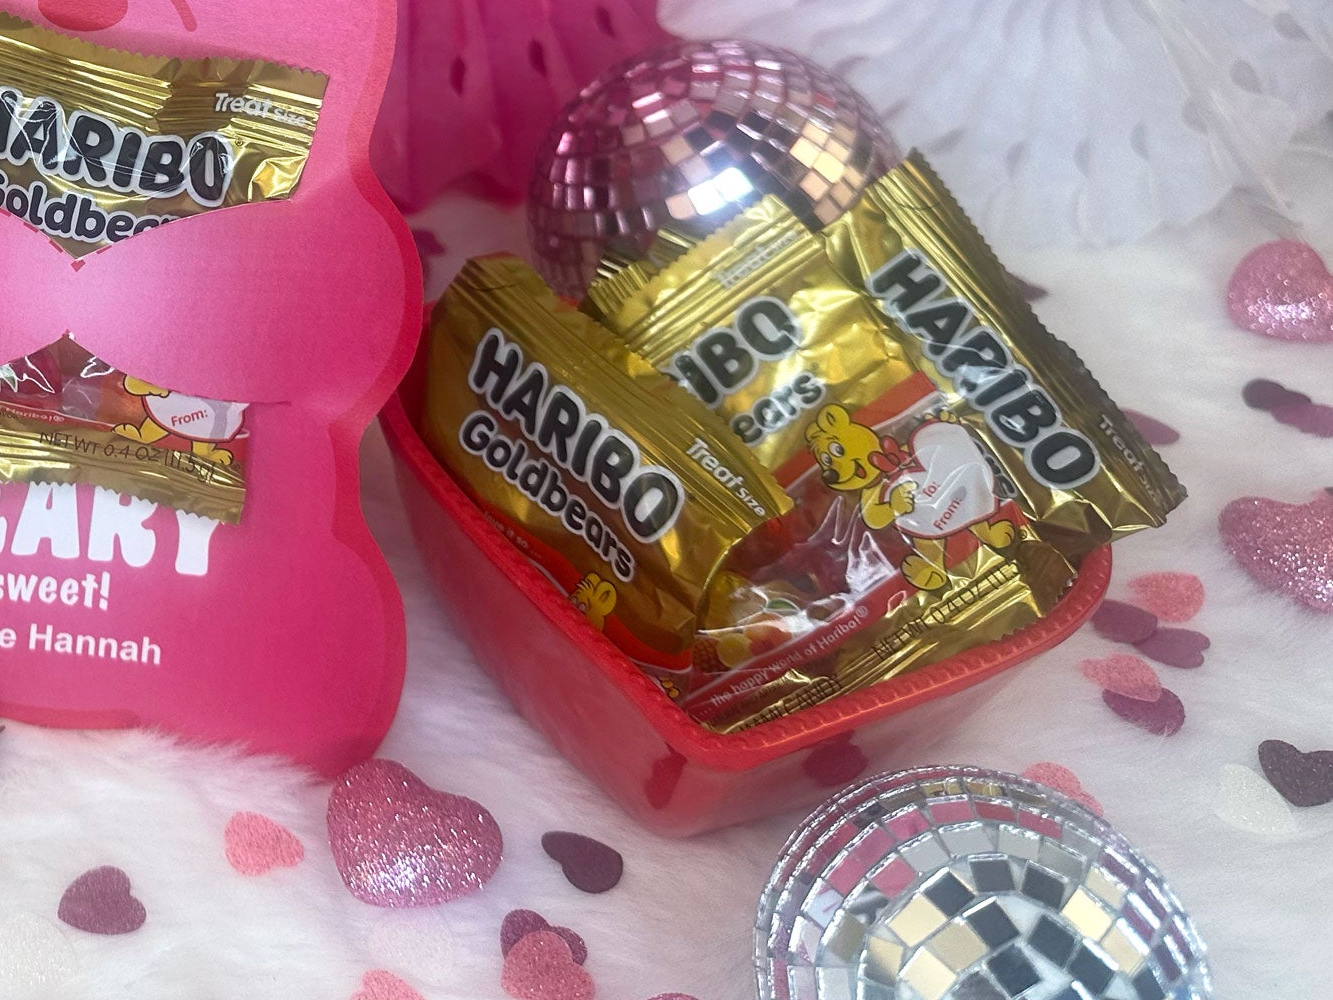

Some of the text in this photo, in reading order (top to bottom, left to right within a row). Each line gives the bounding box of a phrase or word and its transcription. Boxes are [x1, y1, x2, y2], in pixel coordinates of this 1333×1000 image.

[214, 93, 272, 118] Treat
[866, 249, 1099, 488] HARIBO
[170, 408, 208, 427] From:
[469, 328, 683, 543] HARIBO
[39, 432, 73, 448] NET
[75, 438, 99, 457] WT
[103, 445, 130, 460] 0.4
[135, 447, 162, 463] OZ
[686, 437, 744, 488] Treat
[459, 410, 635, 582] Goldbears
[933, 496, 962, 530] From:
[29, 623, 162, 665] Hannah
[730, 672, 767, 695] happy
[768, 651, 801, 673] world
[804, 644, 817, 656] of
